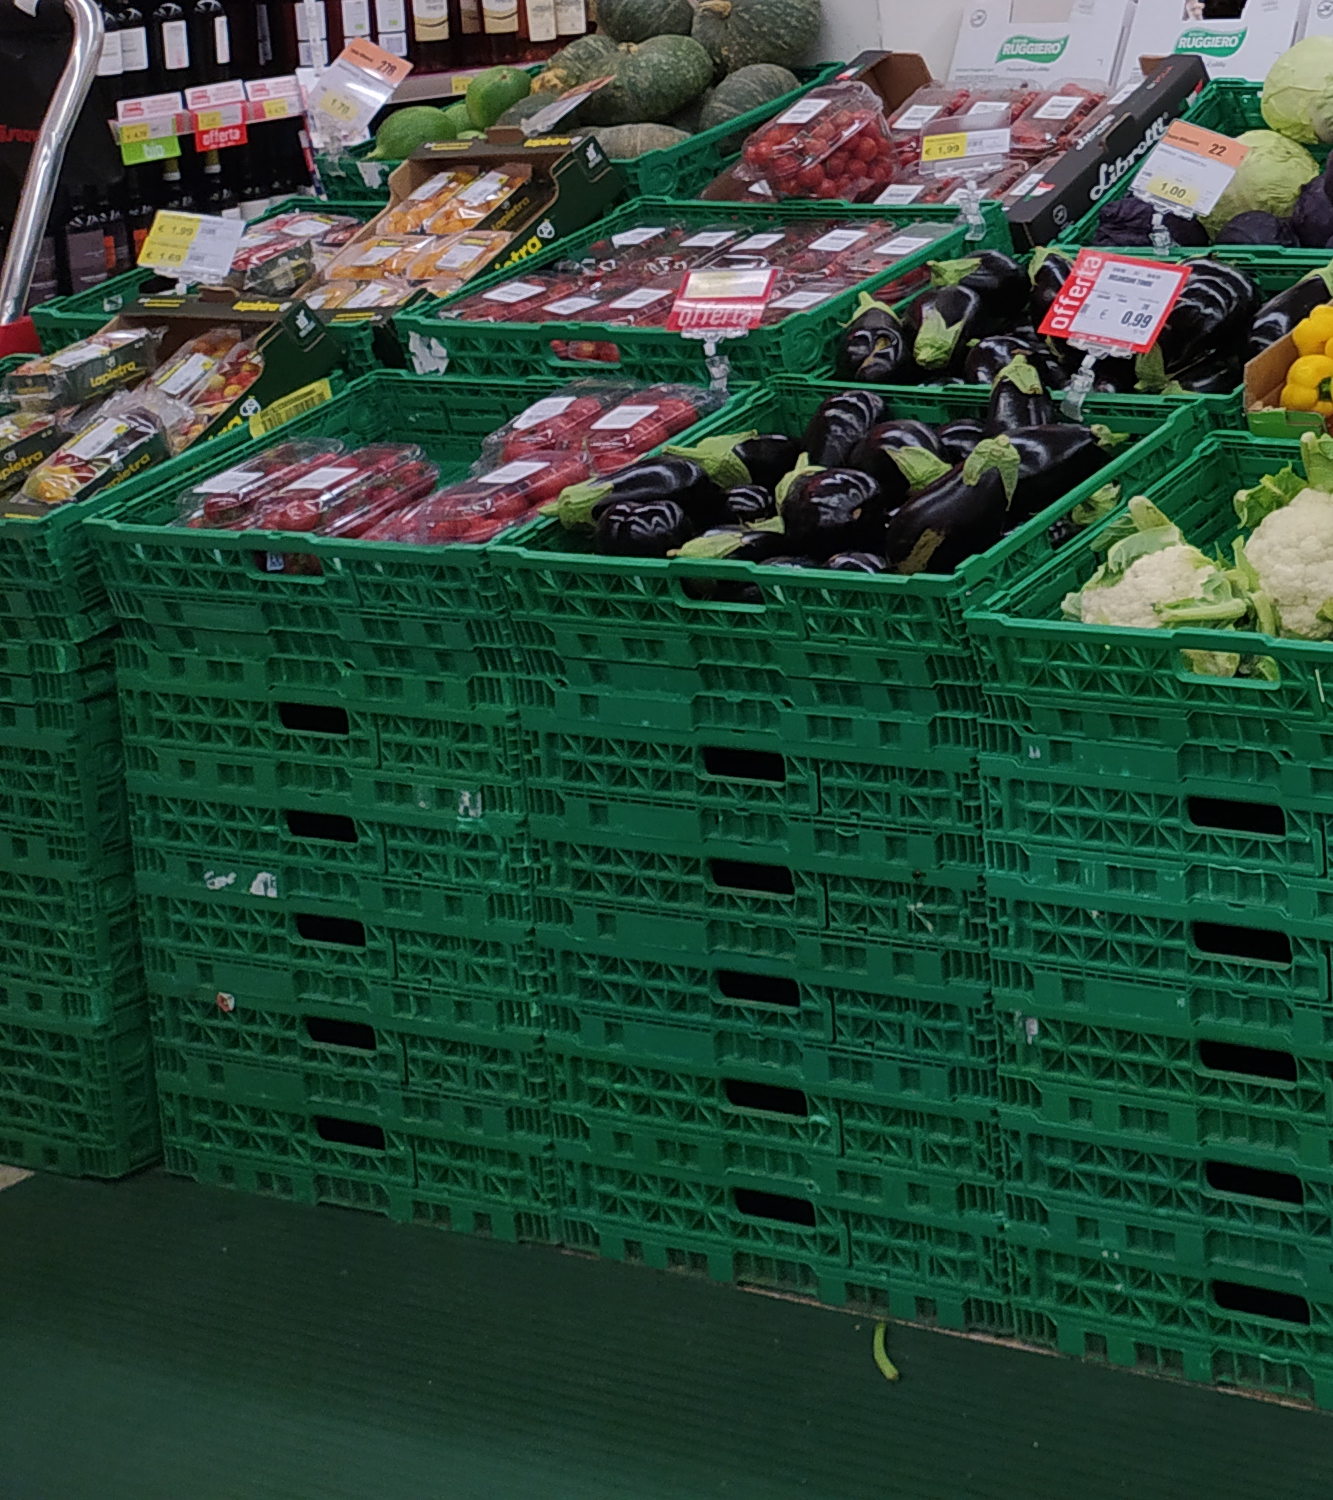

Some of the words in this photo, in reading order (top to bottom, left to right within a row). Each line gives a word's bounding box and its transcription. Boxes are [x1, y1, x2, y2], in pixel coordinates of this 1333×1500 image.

[1003, 40, 1062, 56] RUGGIERO
[1177, 34, 1241, 50] RUGGIERO
[201, 128, 241, 144] offerta
[1207, 143, 1229, 158] 22
[1050, 255, 1103, 331] offerta
[1120, 310, 1154, 330] 0,99
